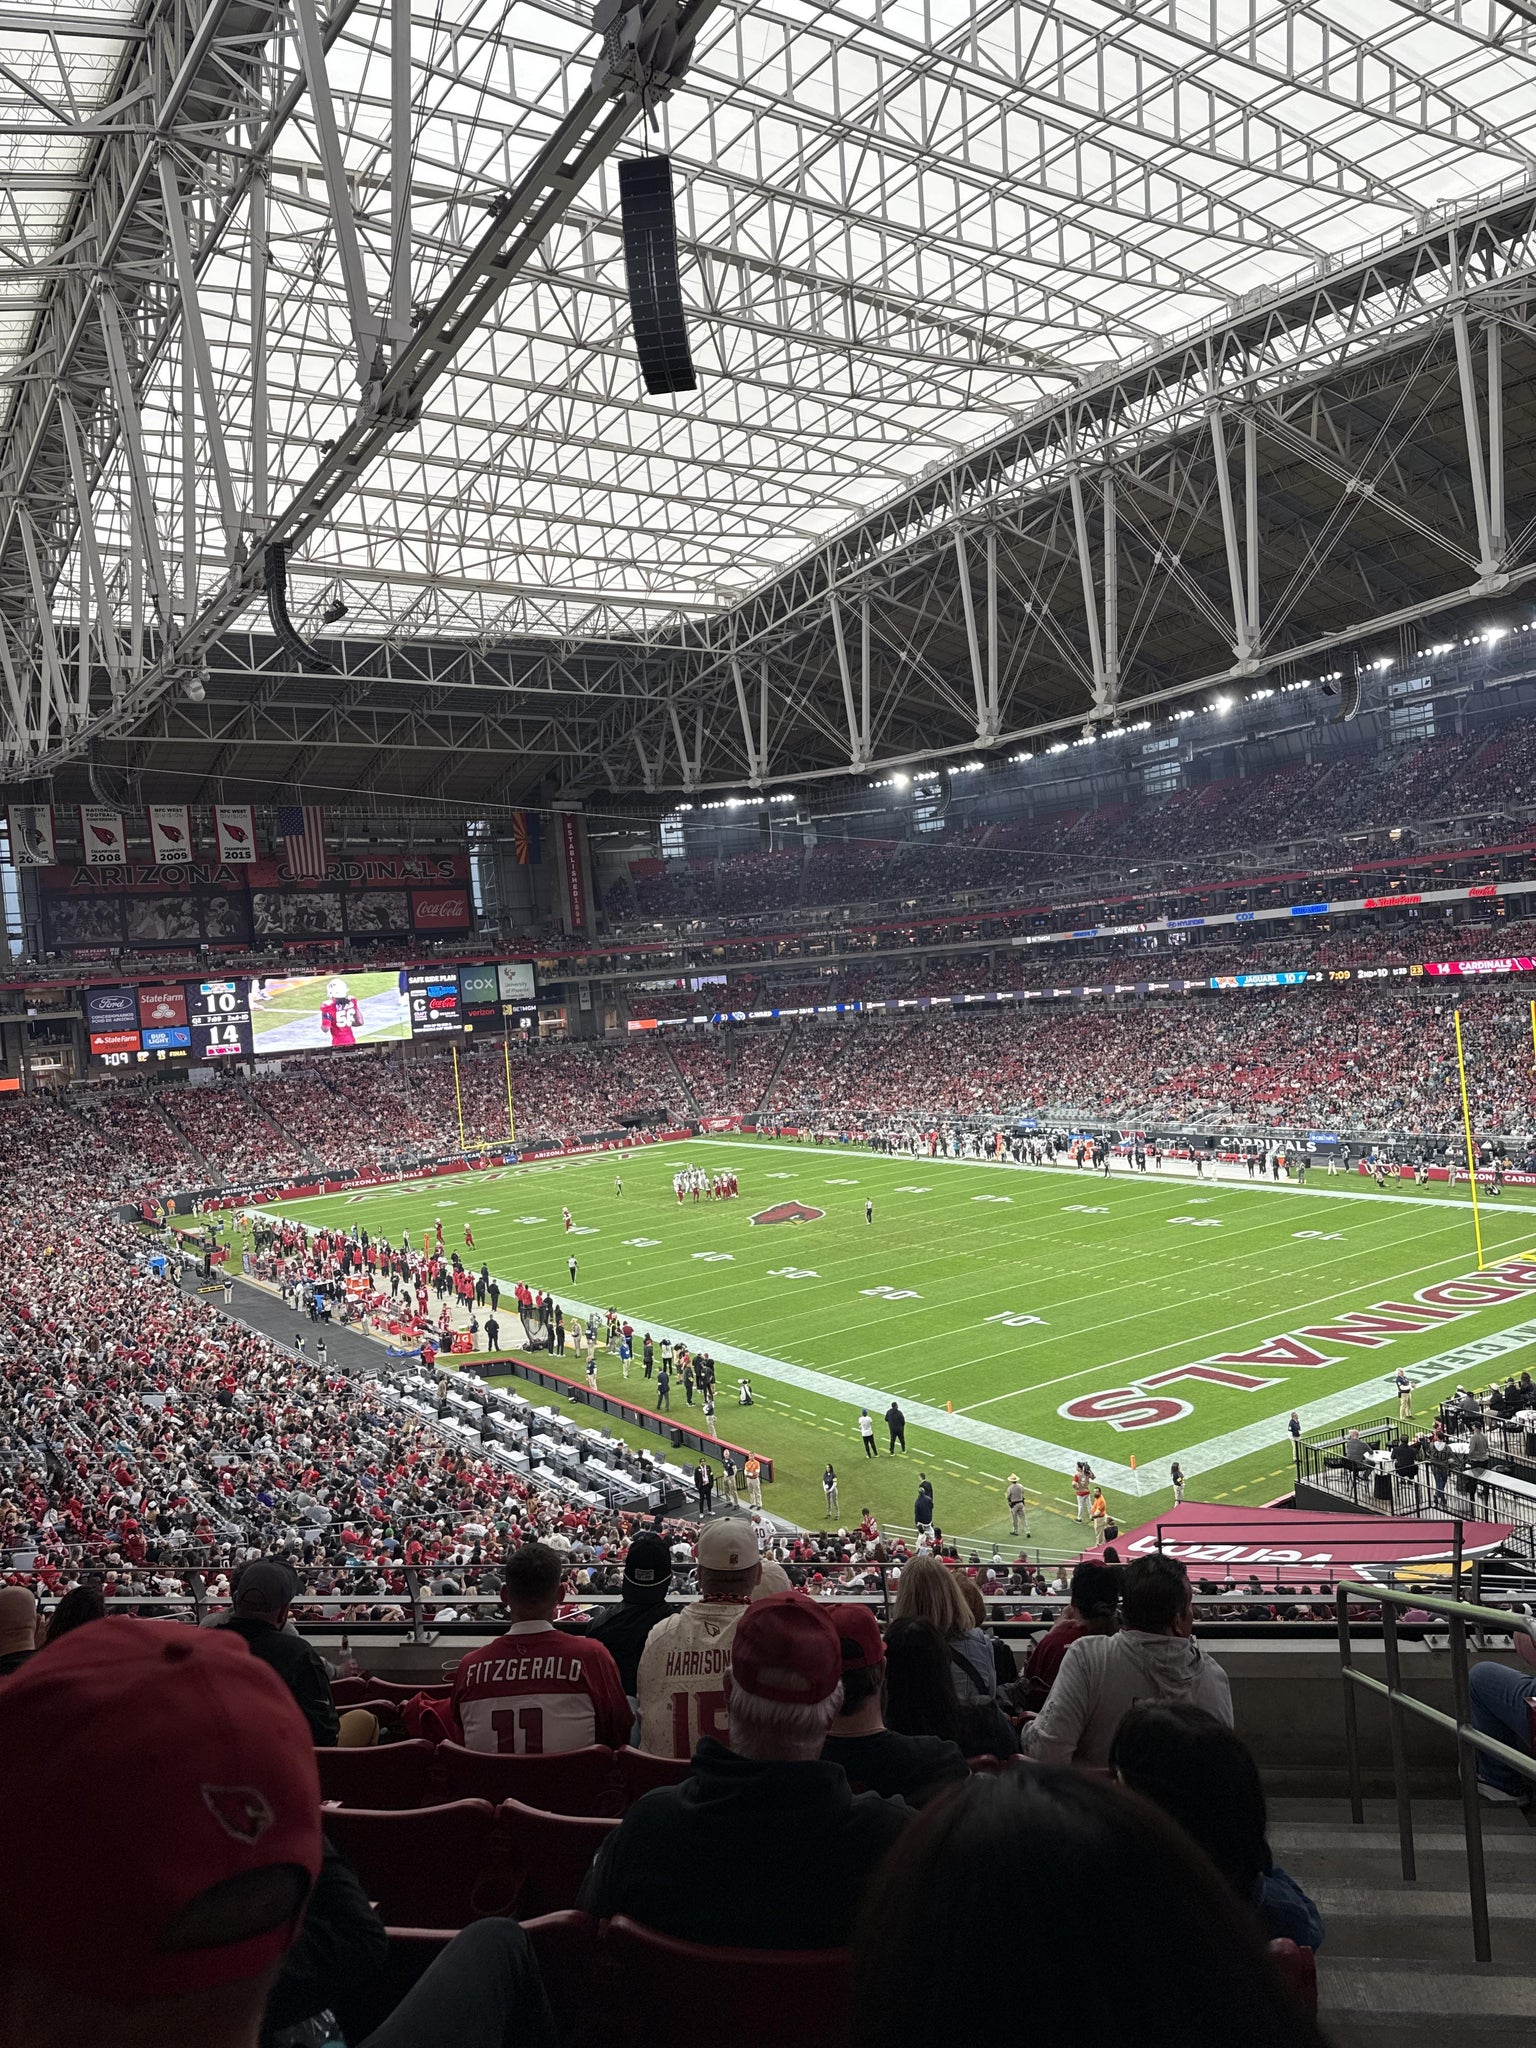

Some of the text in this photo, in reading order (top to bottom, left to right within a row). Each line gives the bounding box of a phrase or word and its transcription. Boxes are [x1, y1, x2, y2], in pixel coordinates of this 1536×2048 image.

[567, 823, 579, 897] ESTABLISHED
[71, 864, 239, 887] ARIZONA
[1114, 926, 1138, 935] SAFEWAY
[1438, 960, 1512, 974] 14 CARDINALS
[1245, 973, 1295, 983] JAGUARS 10
[1316, 972, 1323, 981] 2
[1329, 971, 1350, 980] 7:09
[464, 979, 493, 990] COX
[98, 999, 125, 1008] Ford
[207, 993, 235, 1013] 10
[468, 1009, 495, 1017] verizon
[520, 1017, 532, 1027] 23
[210, 1025, 238, 1044] 14
[101, 1052, 128, 1066] 7:09
[535, 1149, 565, 1158] ARIZONA
[221, 1186, 252, 1195] ARIZONA
[621, 1237, 663, 1247] 50
[690, 1251, 733, 1262] 40
[766, 1267, 814, 1279] 30
[859, 1286, 918, 1300] 20
[984, 1310, 1043, 1327] 10
[666, 1648, 732, 1676] HARRISON
[466, 1656, 582, 1687] FITZGERALD
[491, 1707, 543, 1754] 11
